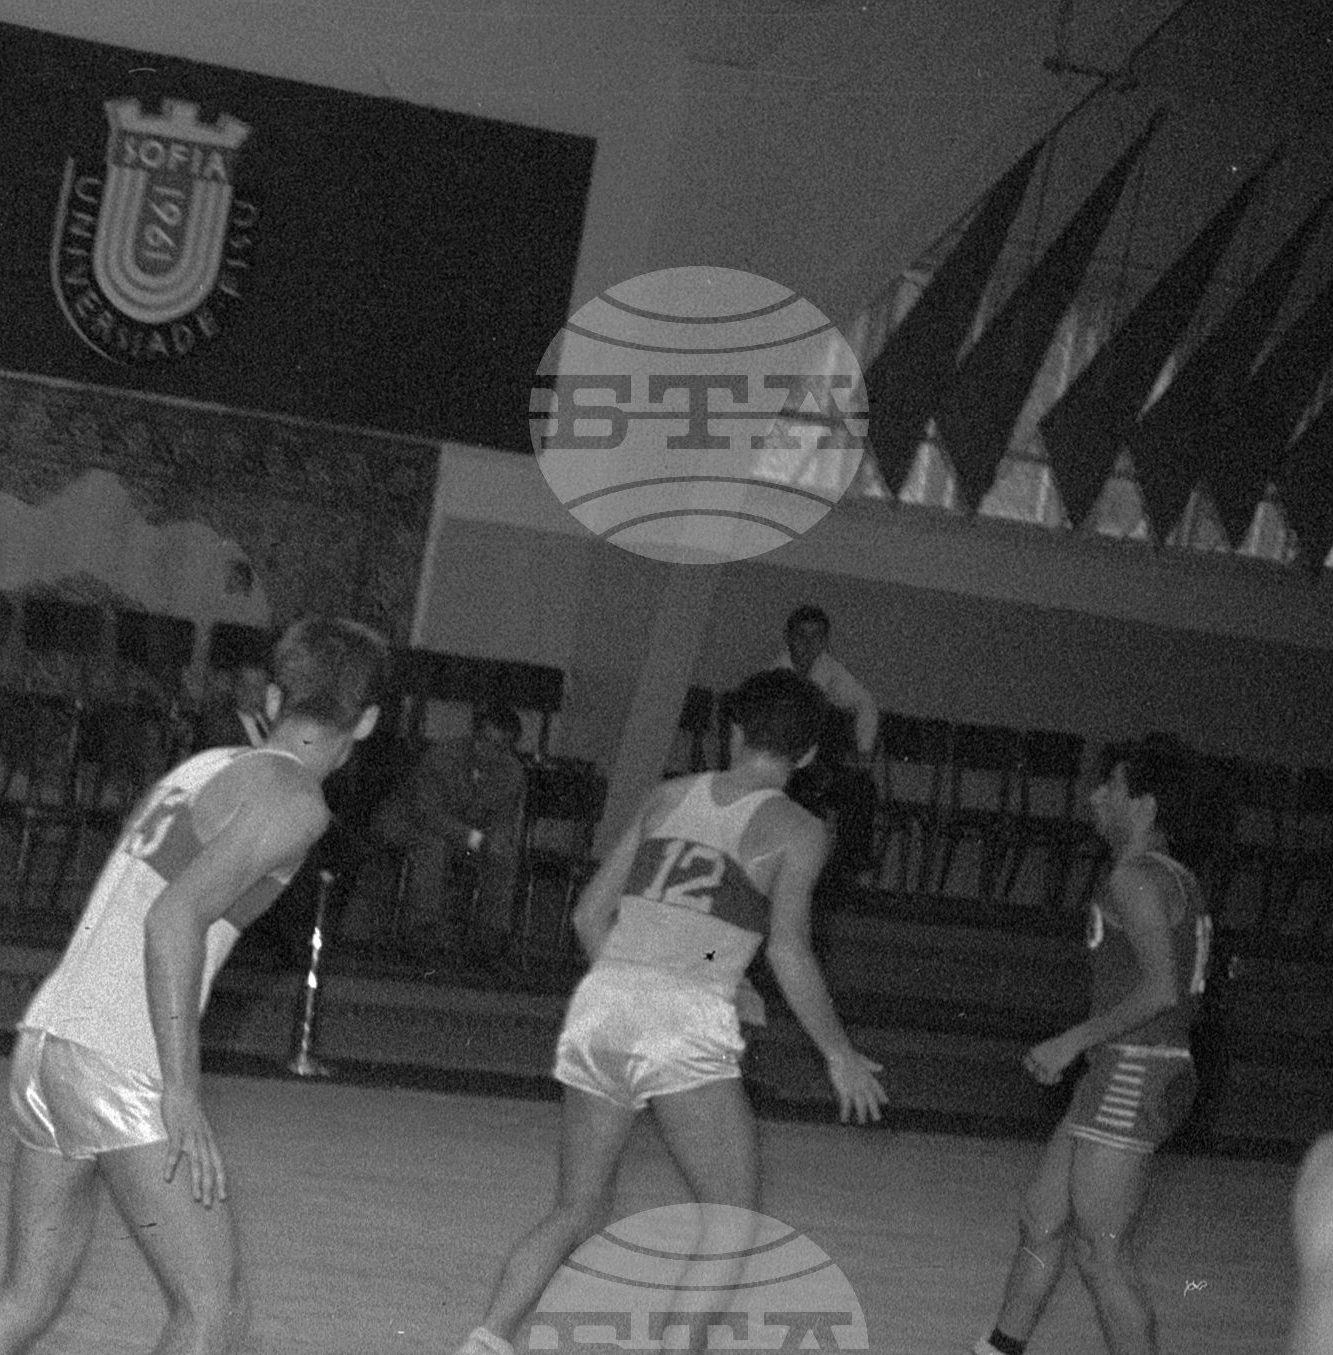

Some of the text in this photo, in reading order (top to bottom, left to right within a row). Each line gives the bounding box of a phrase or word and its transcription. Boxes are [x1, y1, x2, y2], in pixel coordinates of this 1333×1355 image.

[123, 138, 227, 181] SOFIA
[141, 185, 186, 261] 1961
[64, 175, 220, 357] UNIVERSIADE
[642, 839, 725, 914] 12
